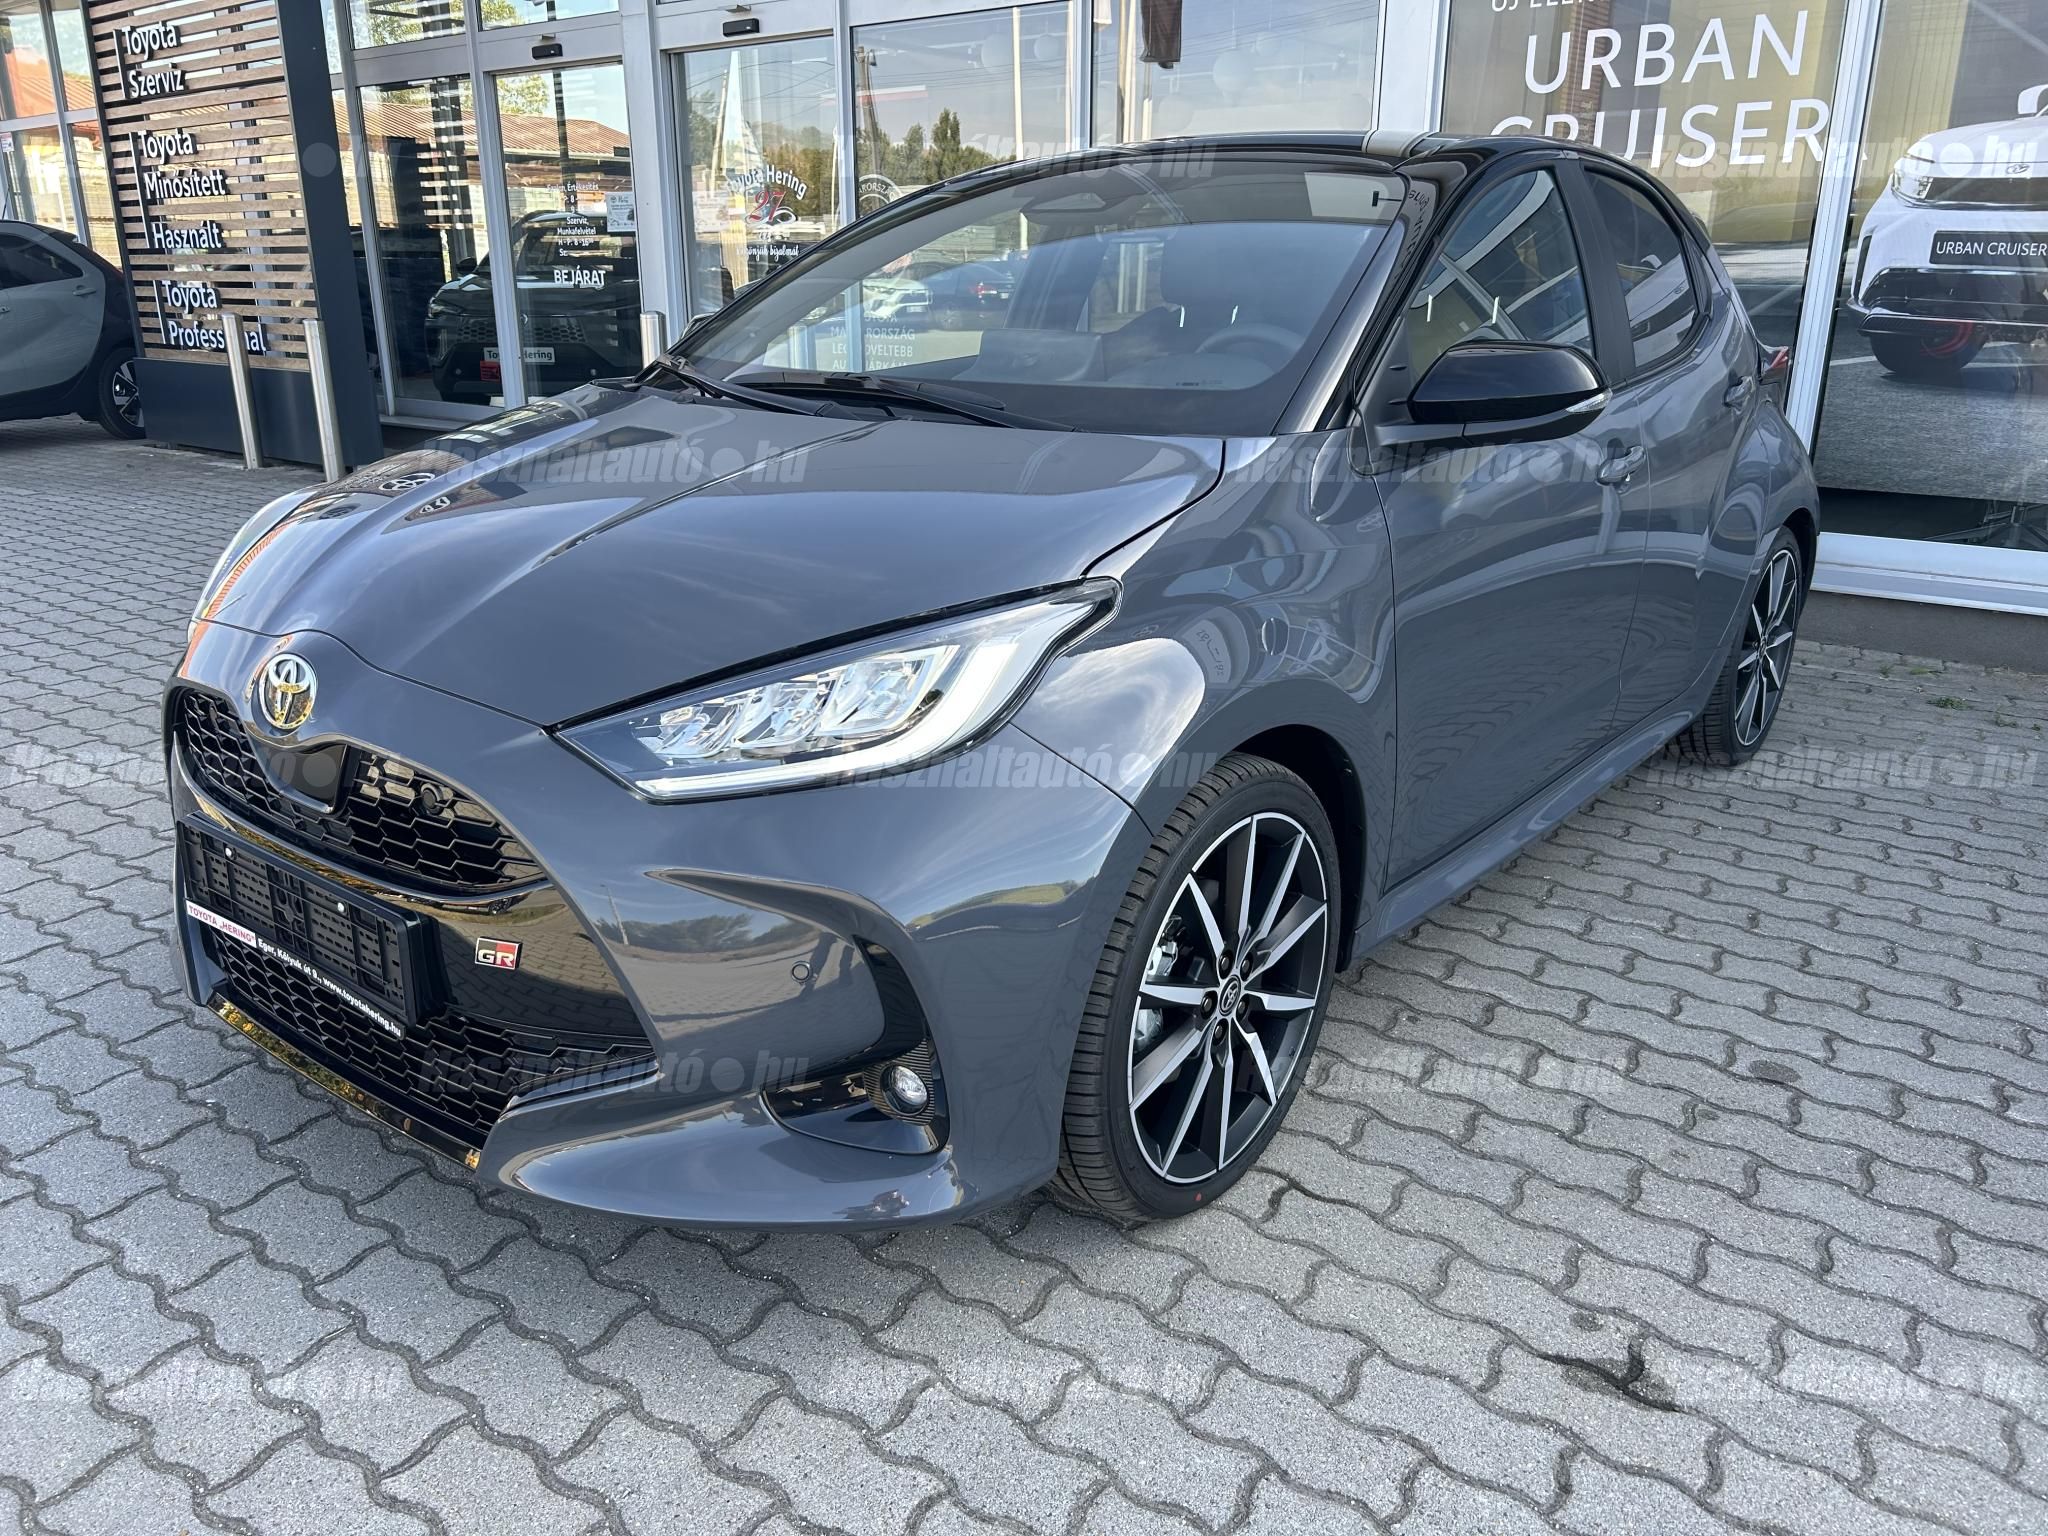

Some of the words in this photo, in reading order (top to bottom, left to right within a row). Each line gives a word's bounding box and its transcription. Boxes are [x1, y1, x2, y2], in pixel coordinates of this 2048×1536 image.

[122, 21, 178, 60] Toyota
[1525, 10, 1809, 94] URBAN
[129, 63, 185, 98] Szerviz
[138, 129, 193, 165] Toyota
[143, 168, 226, 199] Minősített
[767, 165, 807, 200] Hering
[567, 217, 589, 225] Szerviz,
[750, 190, 786, 222] 27
[152, 220, 222, 249] Használt
[557, 227, 597, 235] Munkafelvétel
[1936, 241, 1983, 255] URBAN
[1987, 242, 2048, 256] CRUISER
[553, 265, 606, 286] BEJÁRAT
[162, 280, 217, 314] Toyota
[168, 320, 267, 352] Professnal
[189, 905, 217, 925] TOYOTA
[257, 938, 277, 956] Eger,
[323, 977, 401, 1037] www.toyotahering.hu
[478, 949, 515, 967] GR
